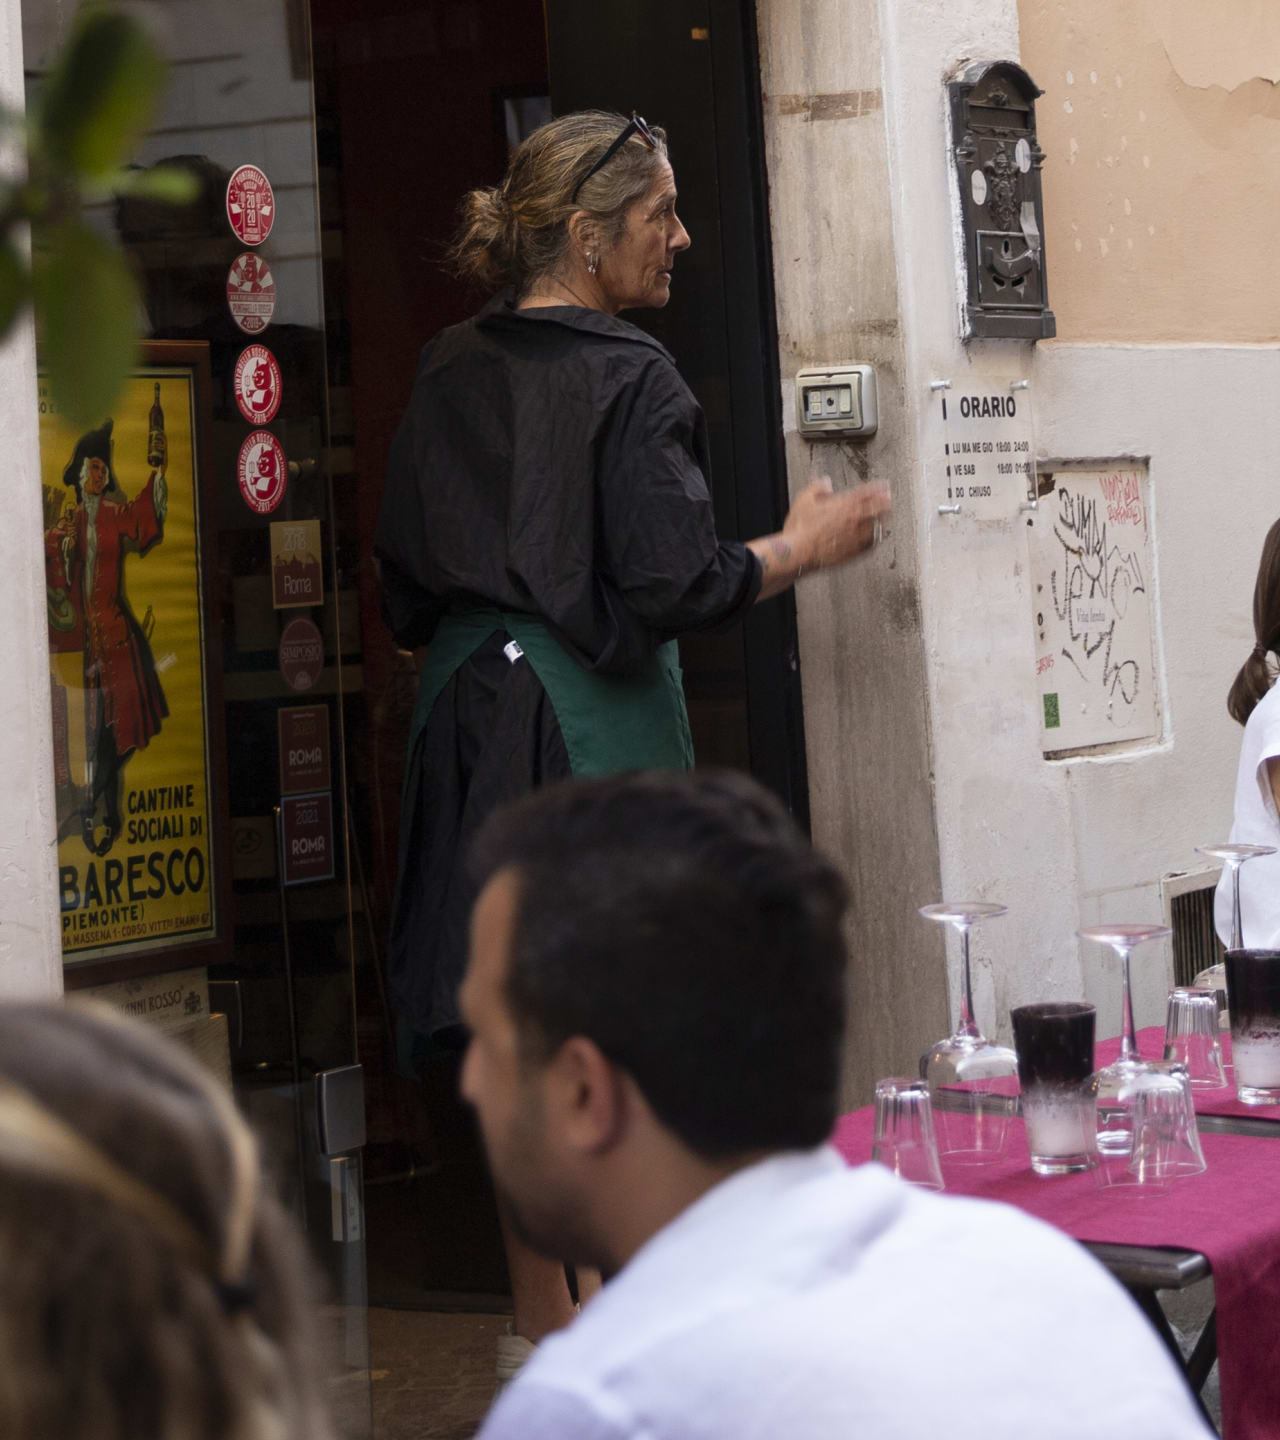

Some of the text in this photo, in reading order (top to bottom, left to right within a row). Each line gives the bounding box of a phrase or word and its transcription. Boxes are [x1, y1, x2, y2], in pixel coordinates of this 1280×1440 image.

[960, 396, 1016, 418] ORARIO
[953, 442, 961, 454] LU
[962, 442, 971, 454] MA
[972, 442, 981, 453] ME
[982, 441, 994, 453] GIO
[954, 464, 962, 475] VE
[963, 464, 976, 475] SAB
[955, 486, 991, 498] DO CHIUSO
[283, 575, 313, 595] Roma
[288, 746, 323, 767] ROMA
[128, 784, 194, 815] CANTINE
[128, 814, 203, 844] SOCIALI DI
[292, 835, 326, 856] ROMA
[60, 847, 206, 913] BARESCO
[73, 930, 111, 946] MASSENA
[122, 924, 147, 938] CORSO
[149, 989, 182, 1013] ROSSO
